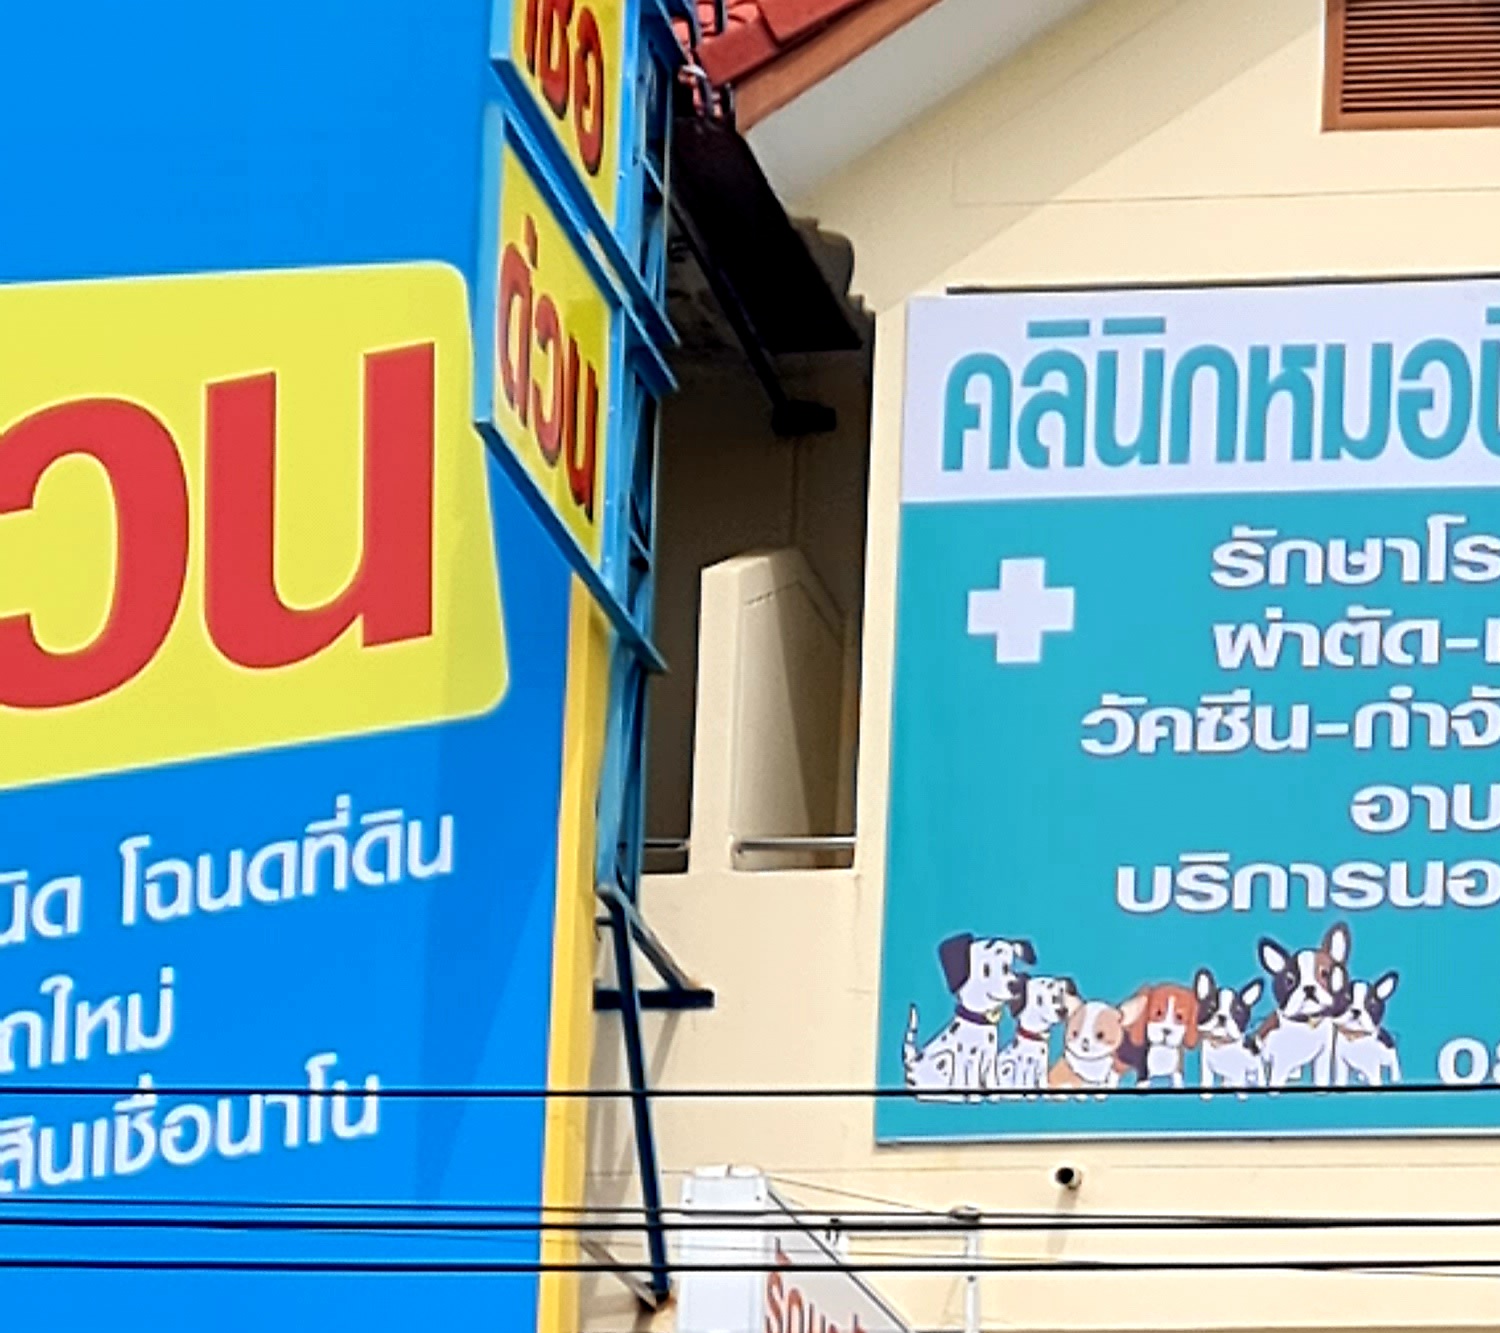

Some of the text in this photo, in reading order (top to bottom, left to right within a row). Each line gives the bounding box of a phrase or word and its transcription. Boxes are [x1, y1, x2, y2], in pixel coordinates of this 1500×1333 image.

[499, 213, 600, 526] ด่วน
[119, 794, 455, 926] โฉนดที่ดิน
